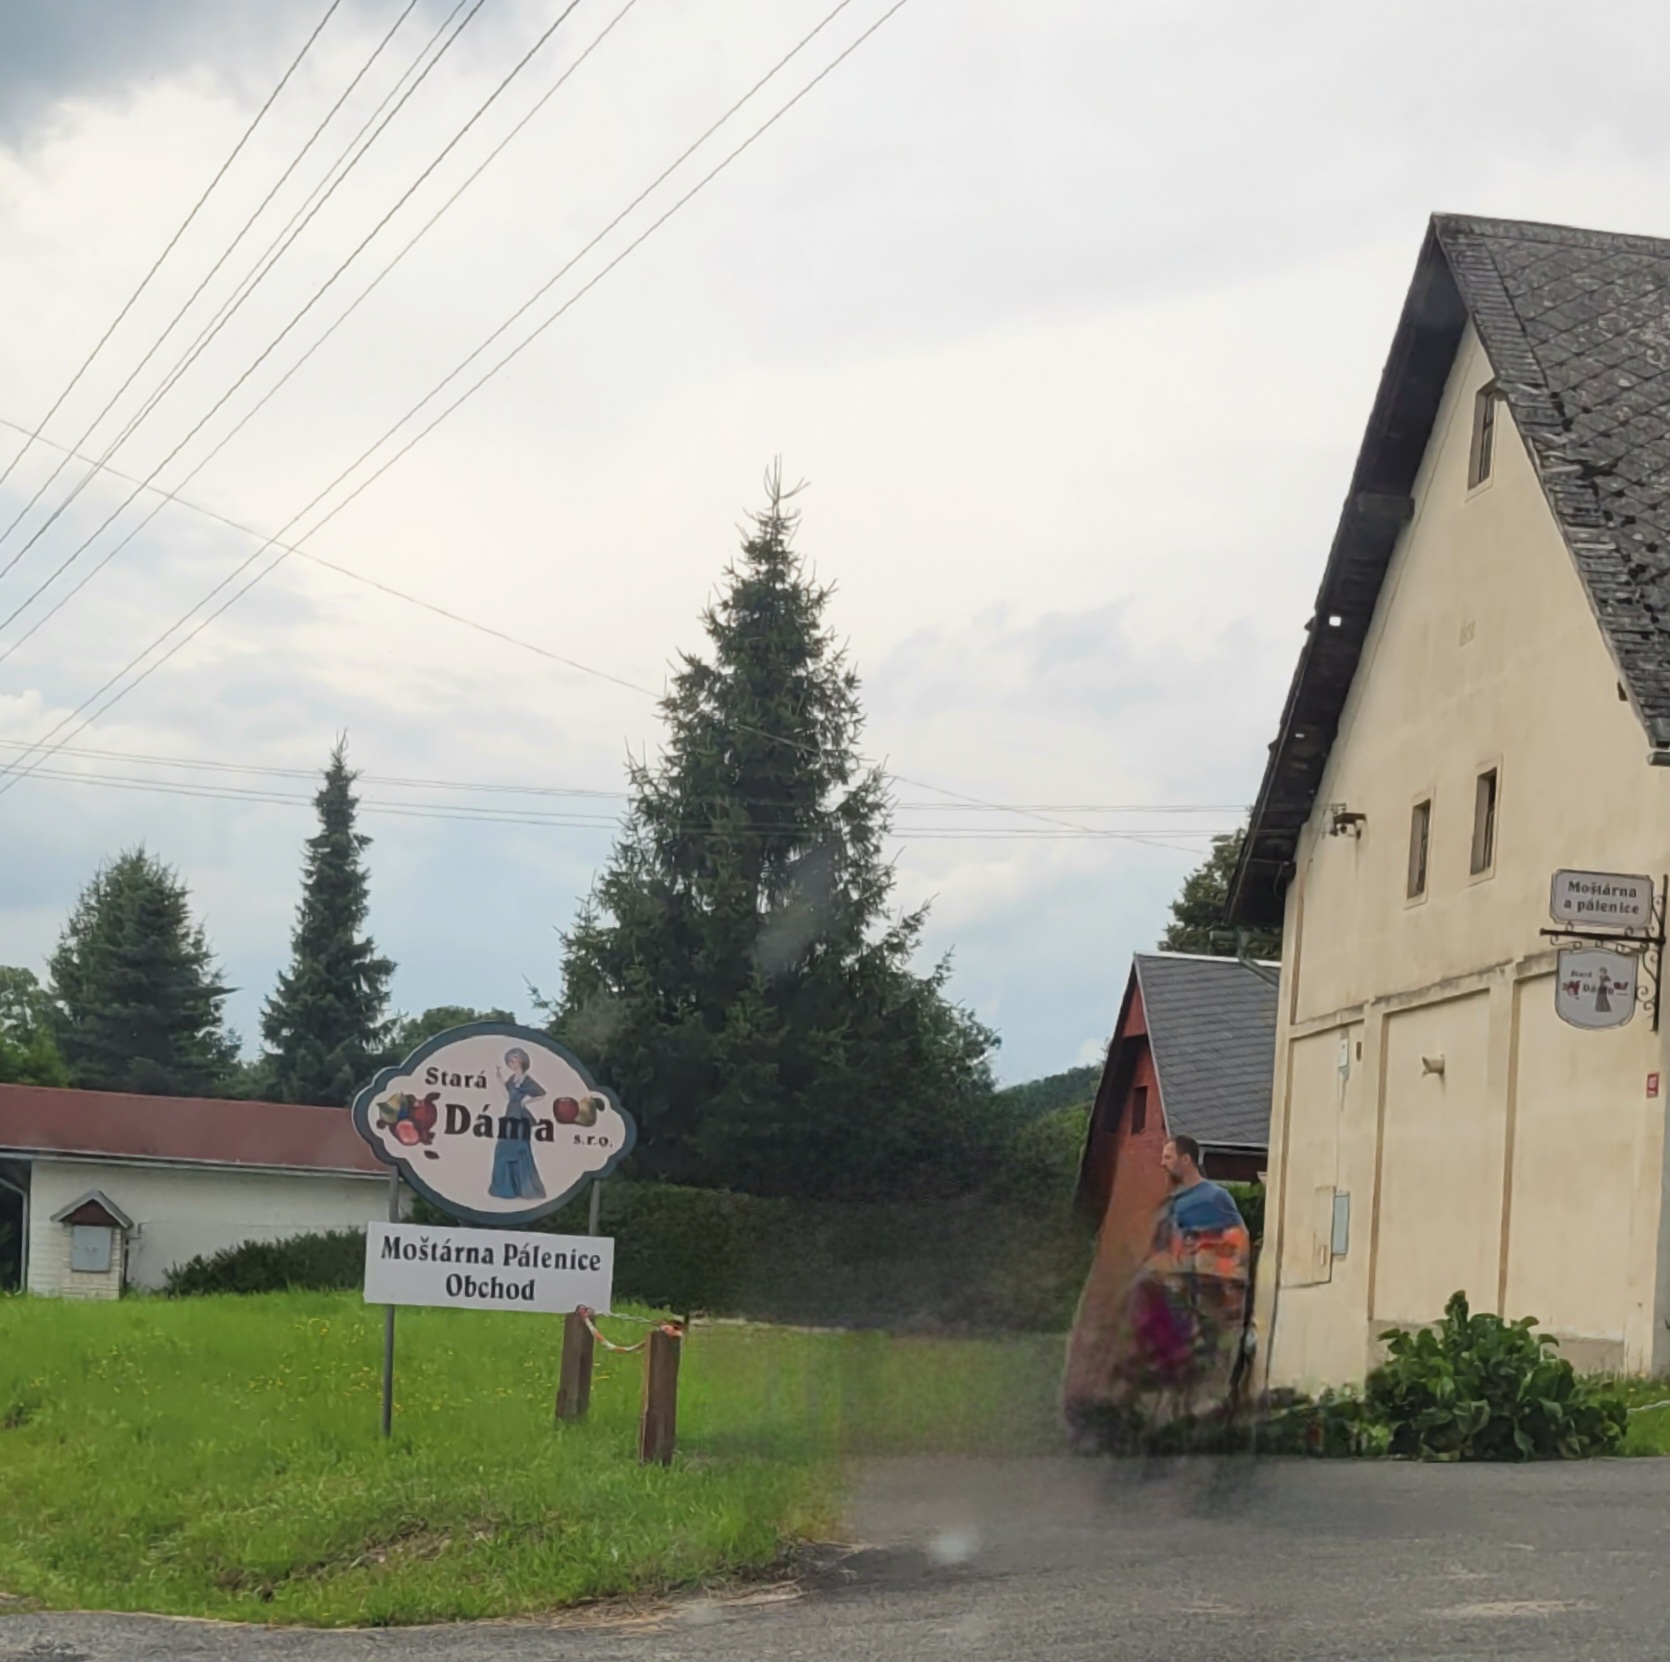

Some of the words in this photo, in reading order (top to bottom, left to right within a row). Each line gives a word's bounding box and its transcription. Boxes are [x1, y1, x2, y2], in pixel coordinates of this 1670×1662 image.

[1568, 881, 1637, 898] Moštárna
[1564, 900, 1572, 909] a
[1577, 899, 1639, 915] pálenice
[1583, 984, 1614, 995] Dáa
[425, 1067, 487, 1089] Stará
[444, 1104, 554, 1142] Dáma
[573, 1134, 613, 1148] s.r.o.
[381, 1235, 494, 1265] Moštárna
[503, 1242, 601, 1271] Pálenice
[446, 1273, 535, 1301] Obchod
